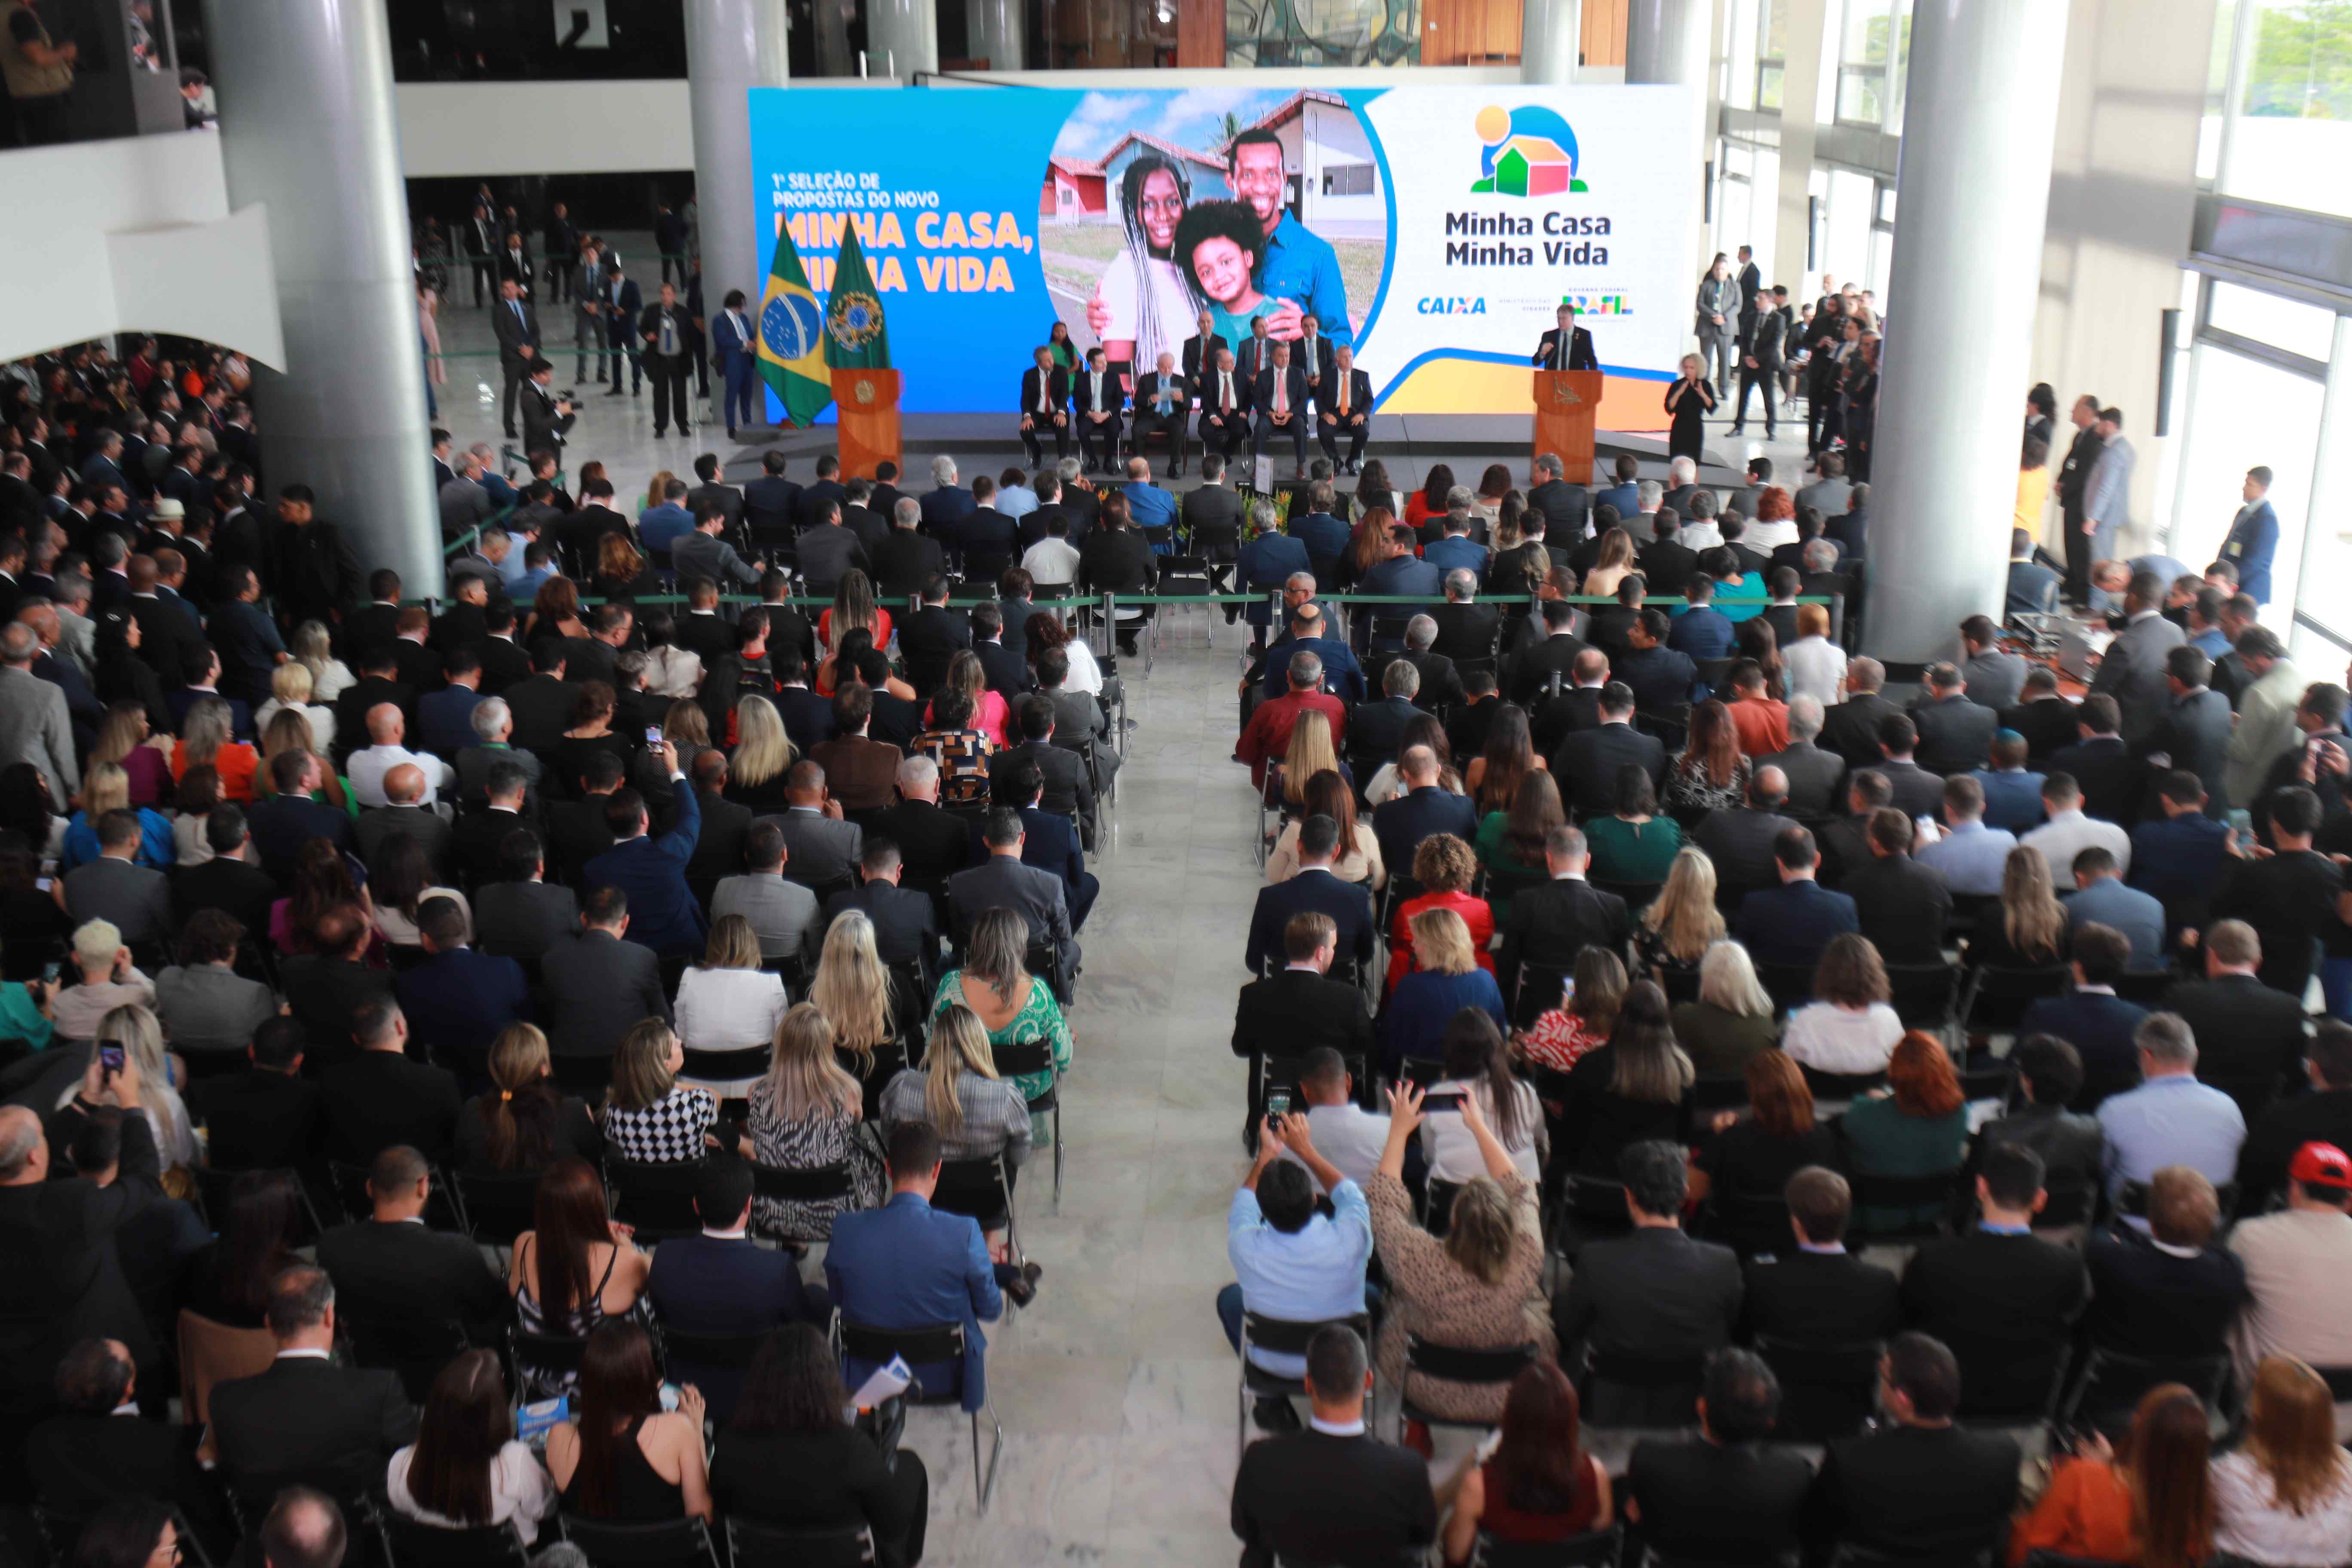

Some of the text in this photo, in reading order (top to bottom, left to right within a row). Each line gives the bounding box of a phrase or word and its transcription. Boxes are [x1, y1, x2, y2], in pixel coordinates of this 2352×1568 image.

[788, 170, 856, 193] SELEÇÃO
[860, 173, 880, 190] DE
[773, 191, 939, 208] PROPOSTAS DO NOVO
[775, 212, 1033, 254] MINHA CASA,
[1446, 211, 1611, 236] Minha Casa
[1446, 241, 1608, 265] Minha Vida
[916, 256, 1015, 292] VIDA
[1417, 297, 1486, 314] CAIXA
